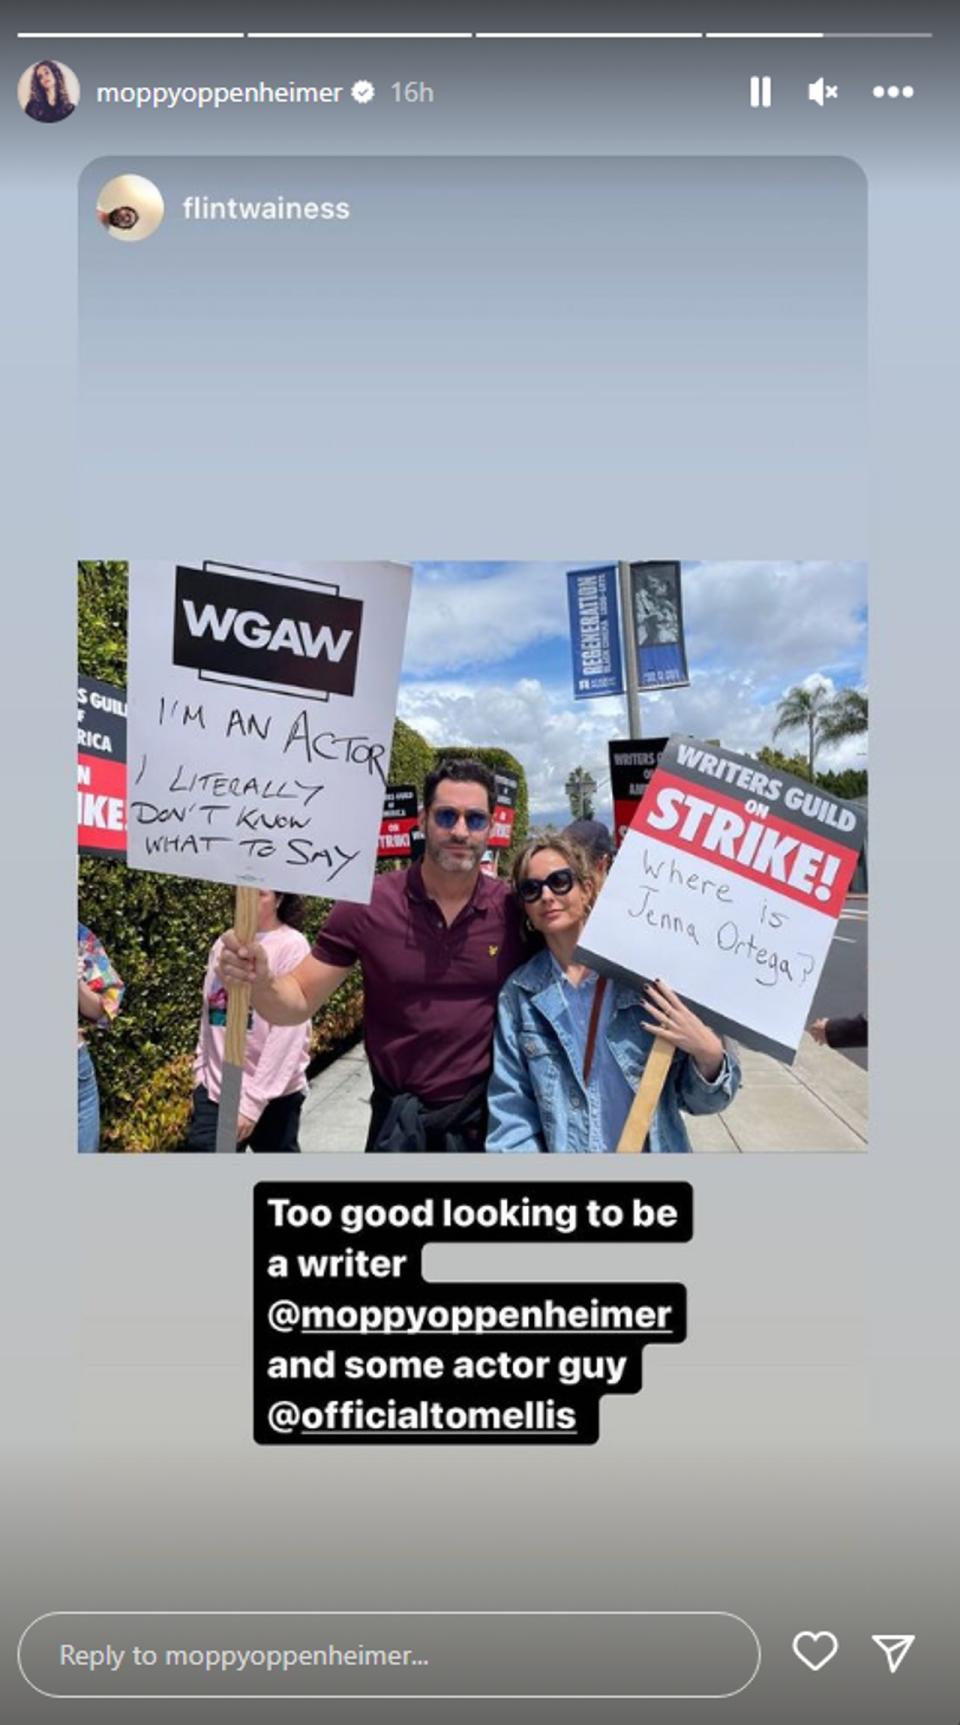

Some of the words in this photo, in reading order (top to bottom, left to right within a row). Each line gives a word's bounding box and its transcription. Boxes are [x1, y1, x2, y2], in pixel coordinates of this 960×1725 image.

[182, 599, 353, 663] WGAW
[577, 575, 603, 676] REGENERATION
[158, 696, 206, 729] I'M
[226, 709, 272, 740] AN
[282, 710, 390, 788] ACTOR
[130, 800, 231, 826] DON'T
[235, 806, 313, 831] KNOW
[168, 764, 325, 806] LITERALLY
[676, 744, 784, 801] WRITERS
[784, 787, 858, 833] GUILD
[744, 799, 771, 820] ON
[145, 834, 233, 857] WHAT
[286, 839, 361, 882] SAY
[646, 787, 842, 902] STRIKE!
[627, 885, 701, 946] Jenna
[716, 920, 816, 988] Ortega?
[759, 898, 791, 929] is
